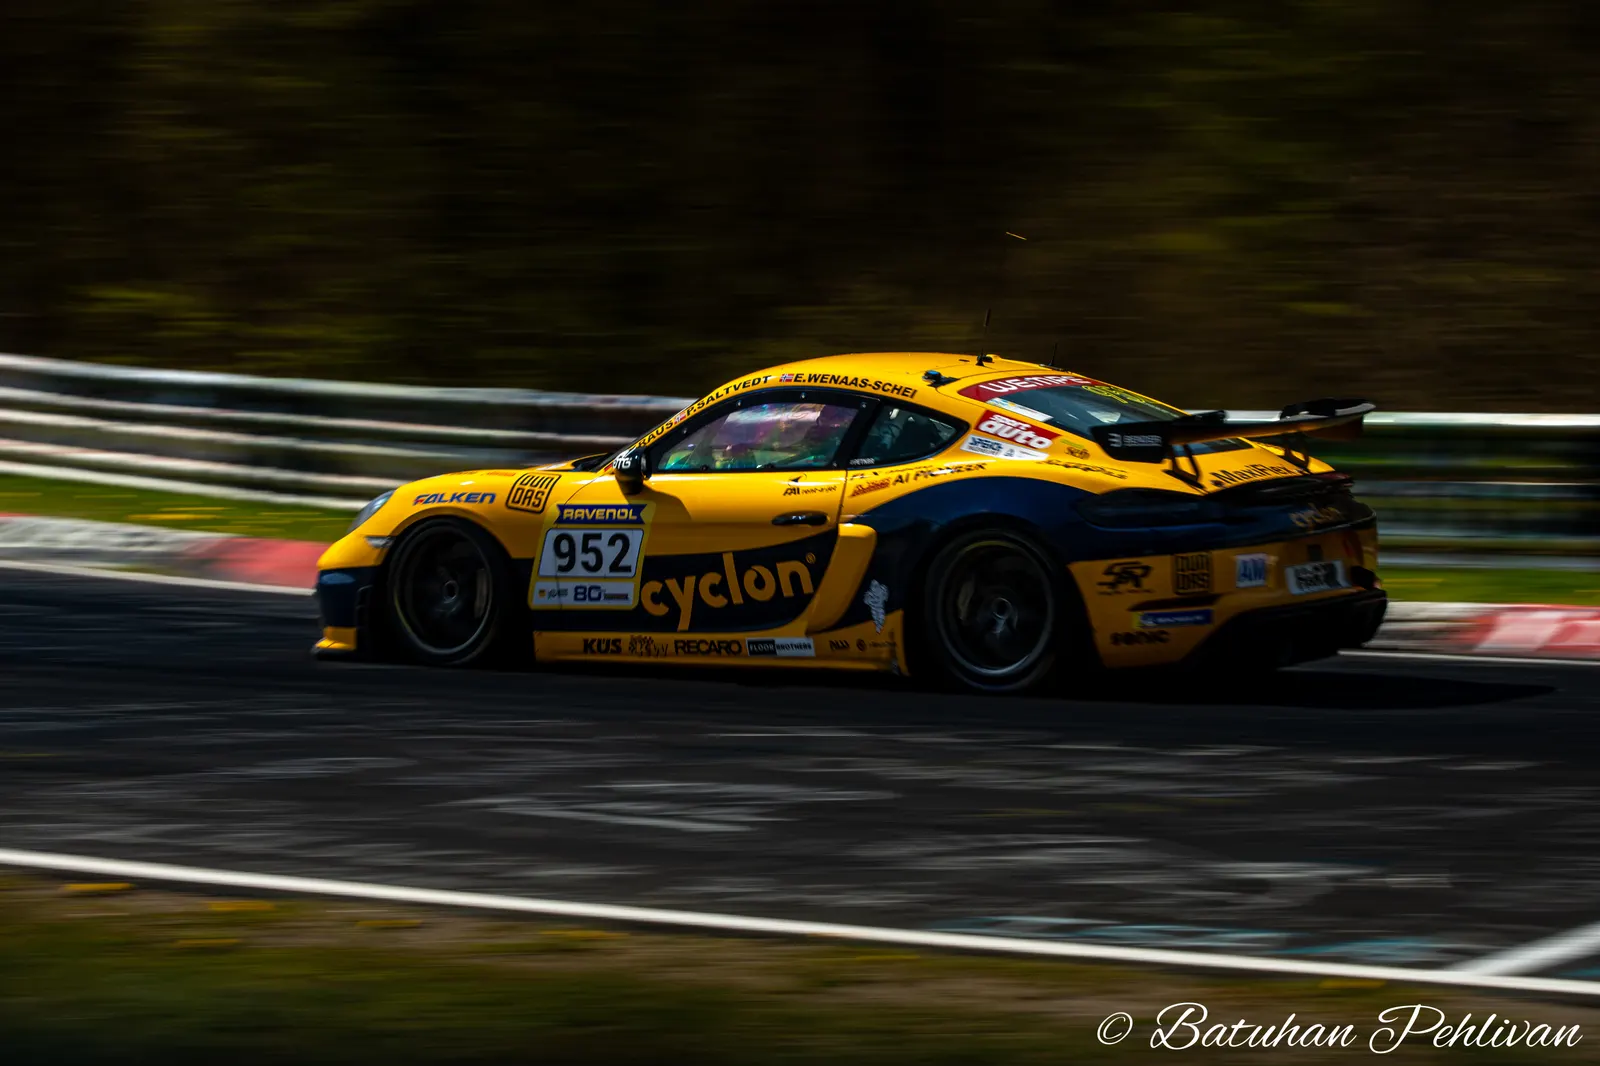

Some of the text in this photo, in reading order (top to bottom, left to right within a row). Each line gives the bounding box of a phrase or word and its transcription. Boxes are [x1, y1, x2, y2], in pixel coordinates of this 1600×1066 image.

[793, 373, 918, 399] E.WENAAS-SCHEI
[978, 419, 1053, 450] auto
[412, 491, 497, 507] FALKEN
[563, 508, 638, 520] RAVENOL
[553, 532, 632, 573] 952
[640, 552, 815, 633] cyclon
[674, 639, 742, 655] RECARO
